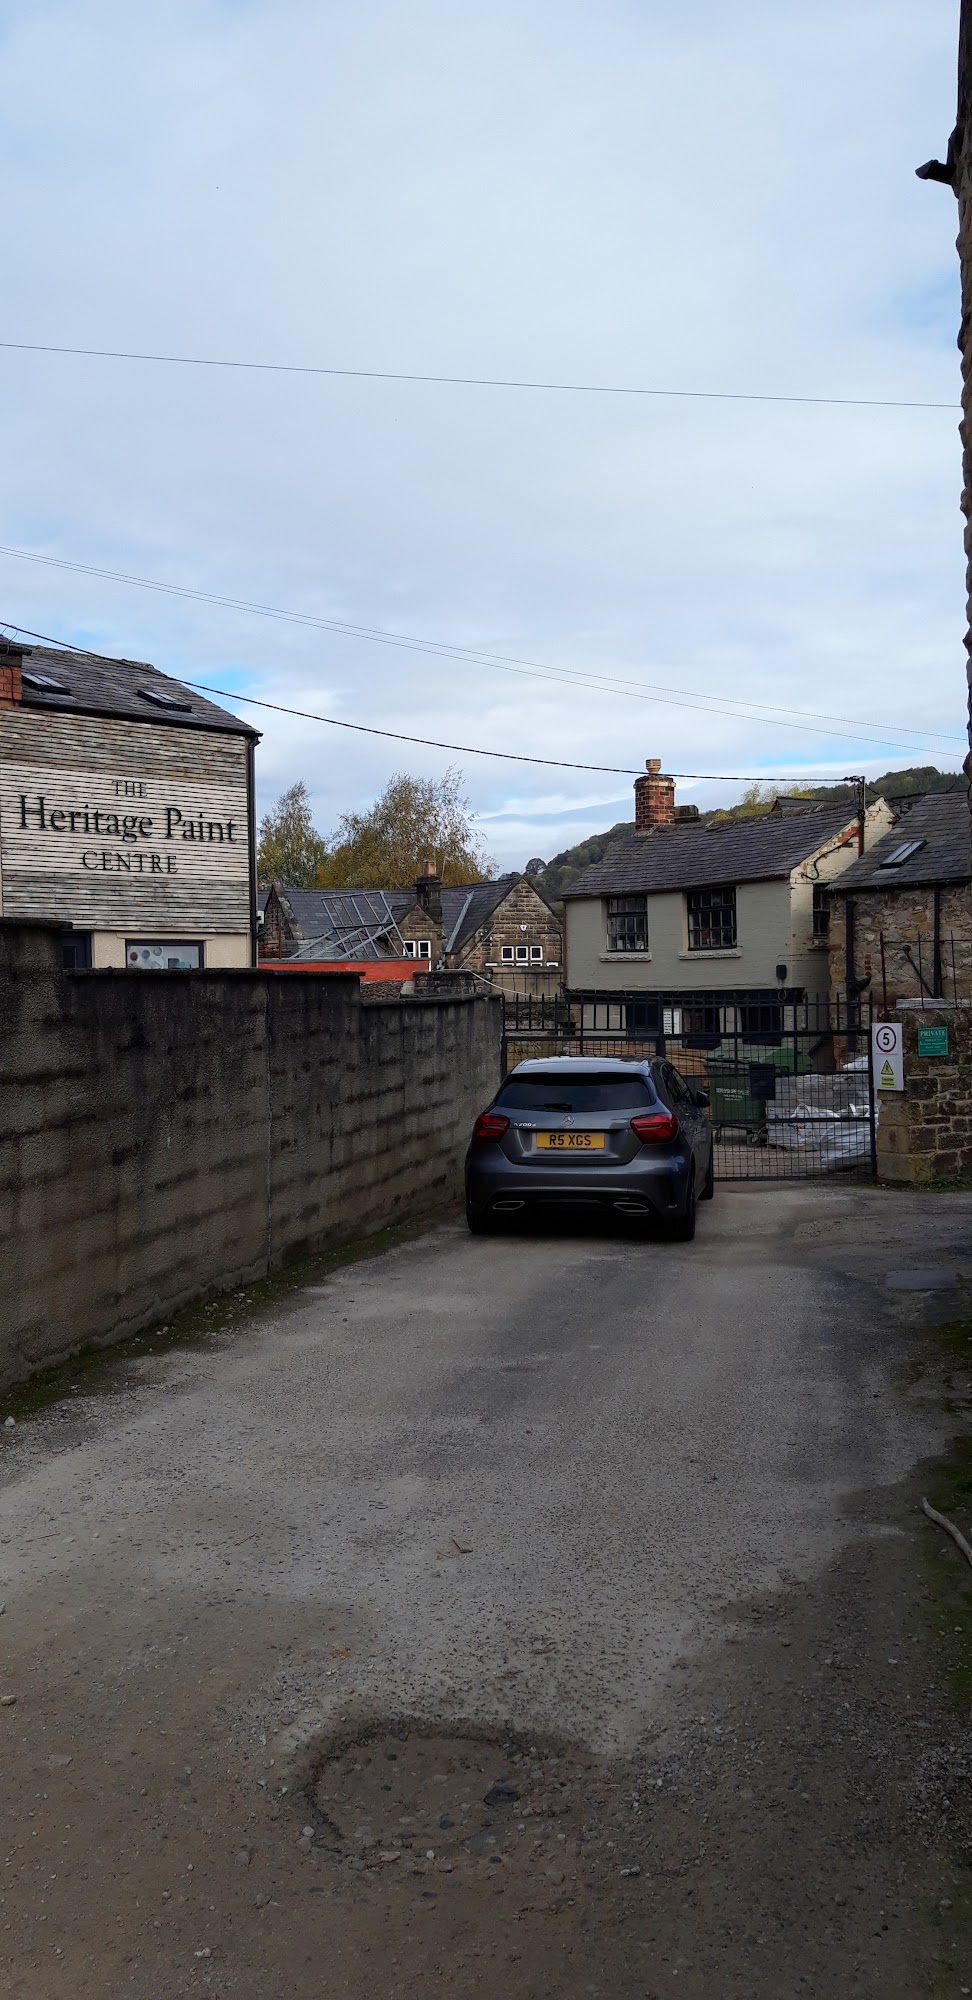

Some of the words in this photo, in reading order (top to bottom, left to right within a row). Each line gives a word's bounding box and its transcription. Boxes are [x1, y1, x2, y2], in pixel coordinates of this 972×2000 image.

[112, 780, 148, 797] THE
[18, 795, 153, 843] Heritage
[165, 806, 238, 842] Paint
[82, 851, 179, 874] CENTRE
[882, 1032, 890, 1046] 5
[549, 1134, 565, 1146] R5
[568, 1134, 592, 1146] XGS
